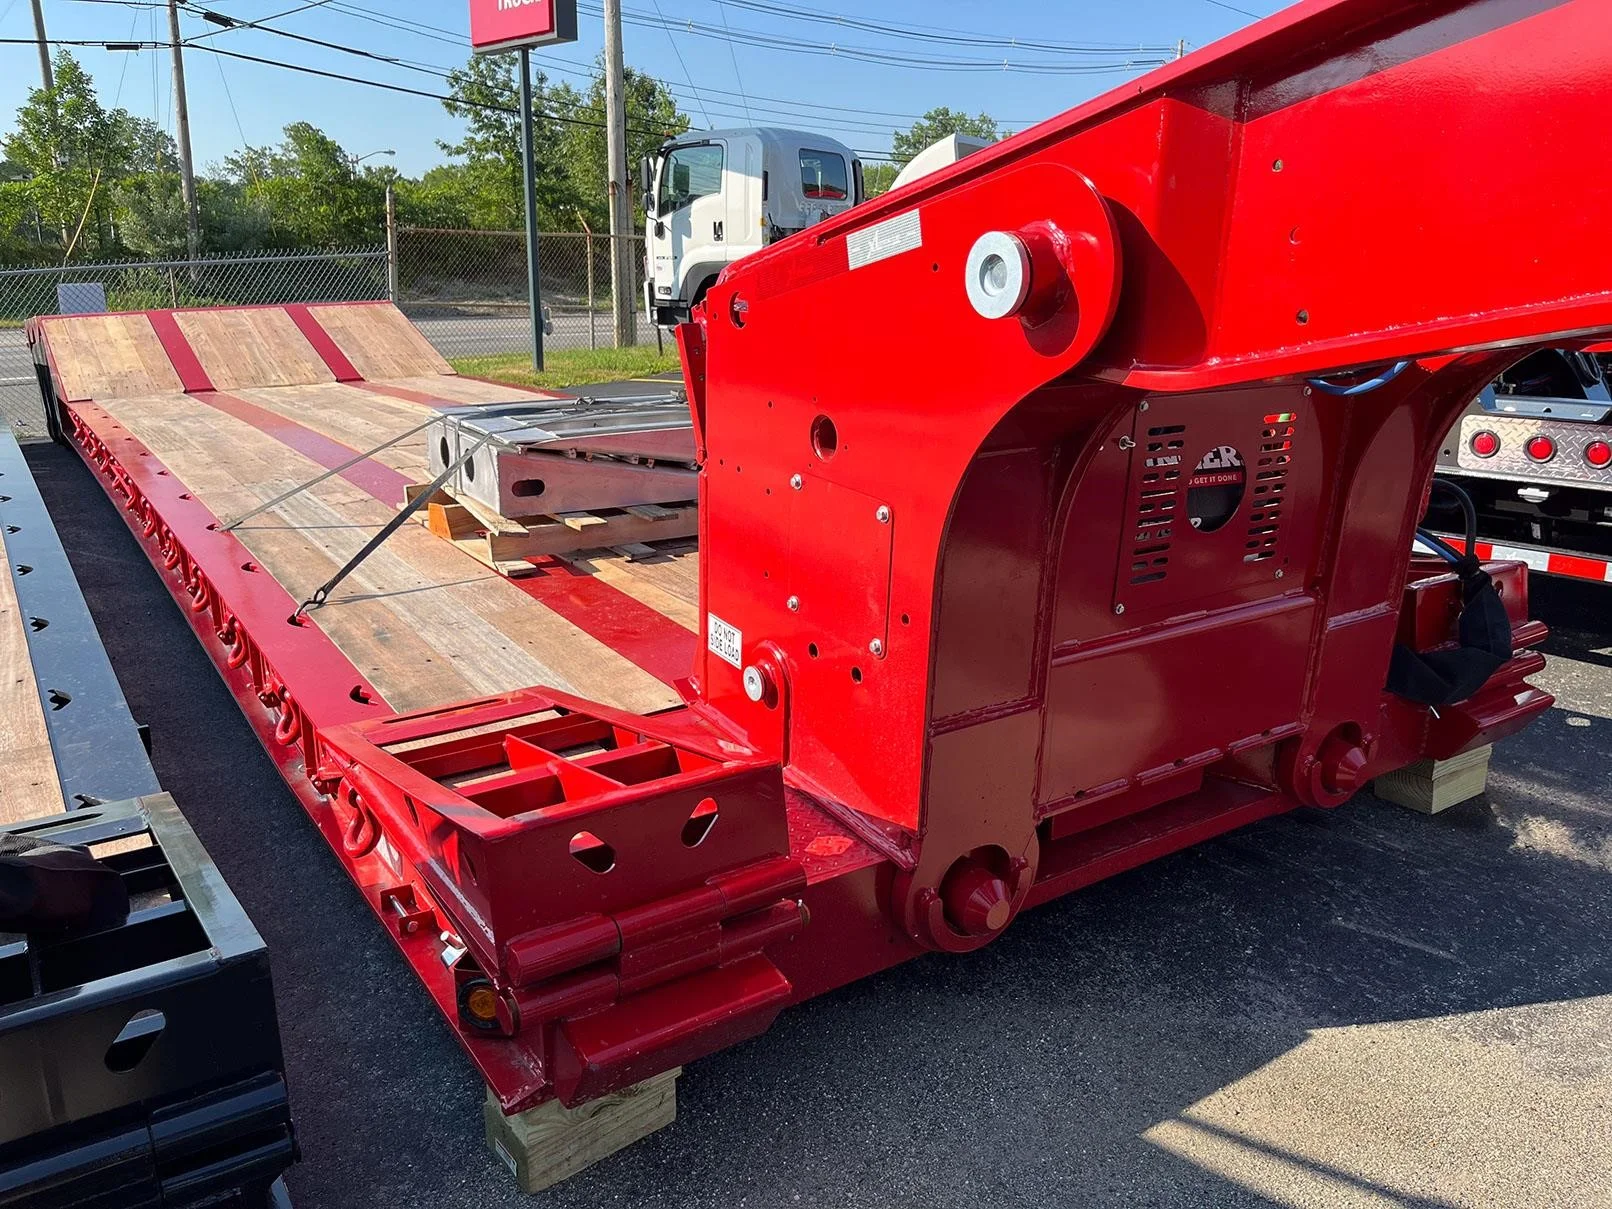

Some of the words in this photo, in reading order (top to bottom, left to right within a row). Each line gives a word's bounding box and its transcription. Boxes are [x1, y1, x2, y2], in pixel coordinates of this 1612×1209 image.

[497, 0, 542, 11] TRU
[1194, 476, 1208, 484] GET
[1217, 474, 1238, 482] DONE
[714, 621, 722, 636] DO
[723, 627, 736, 644] NOT
[711, 633, 723, 651] SIDE
[724, 642, 740, 662] LOAD
